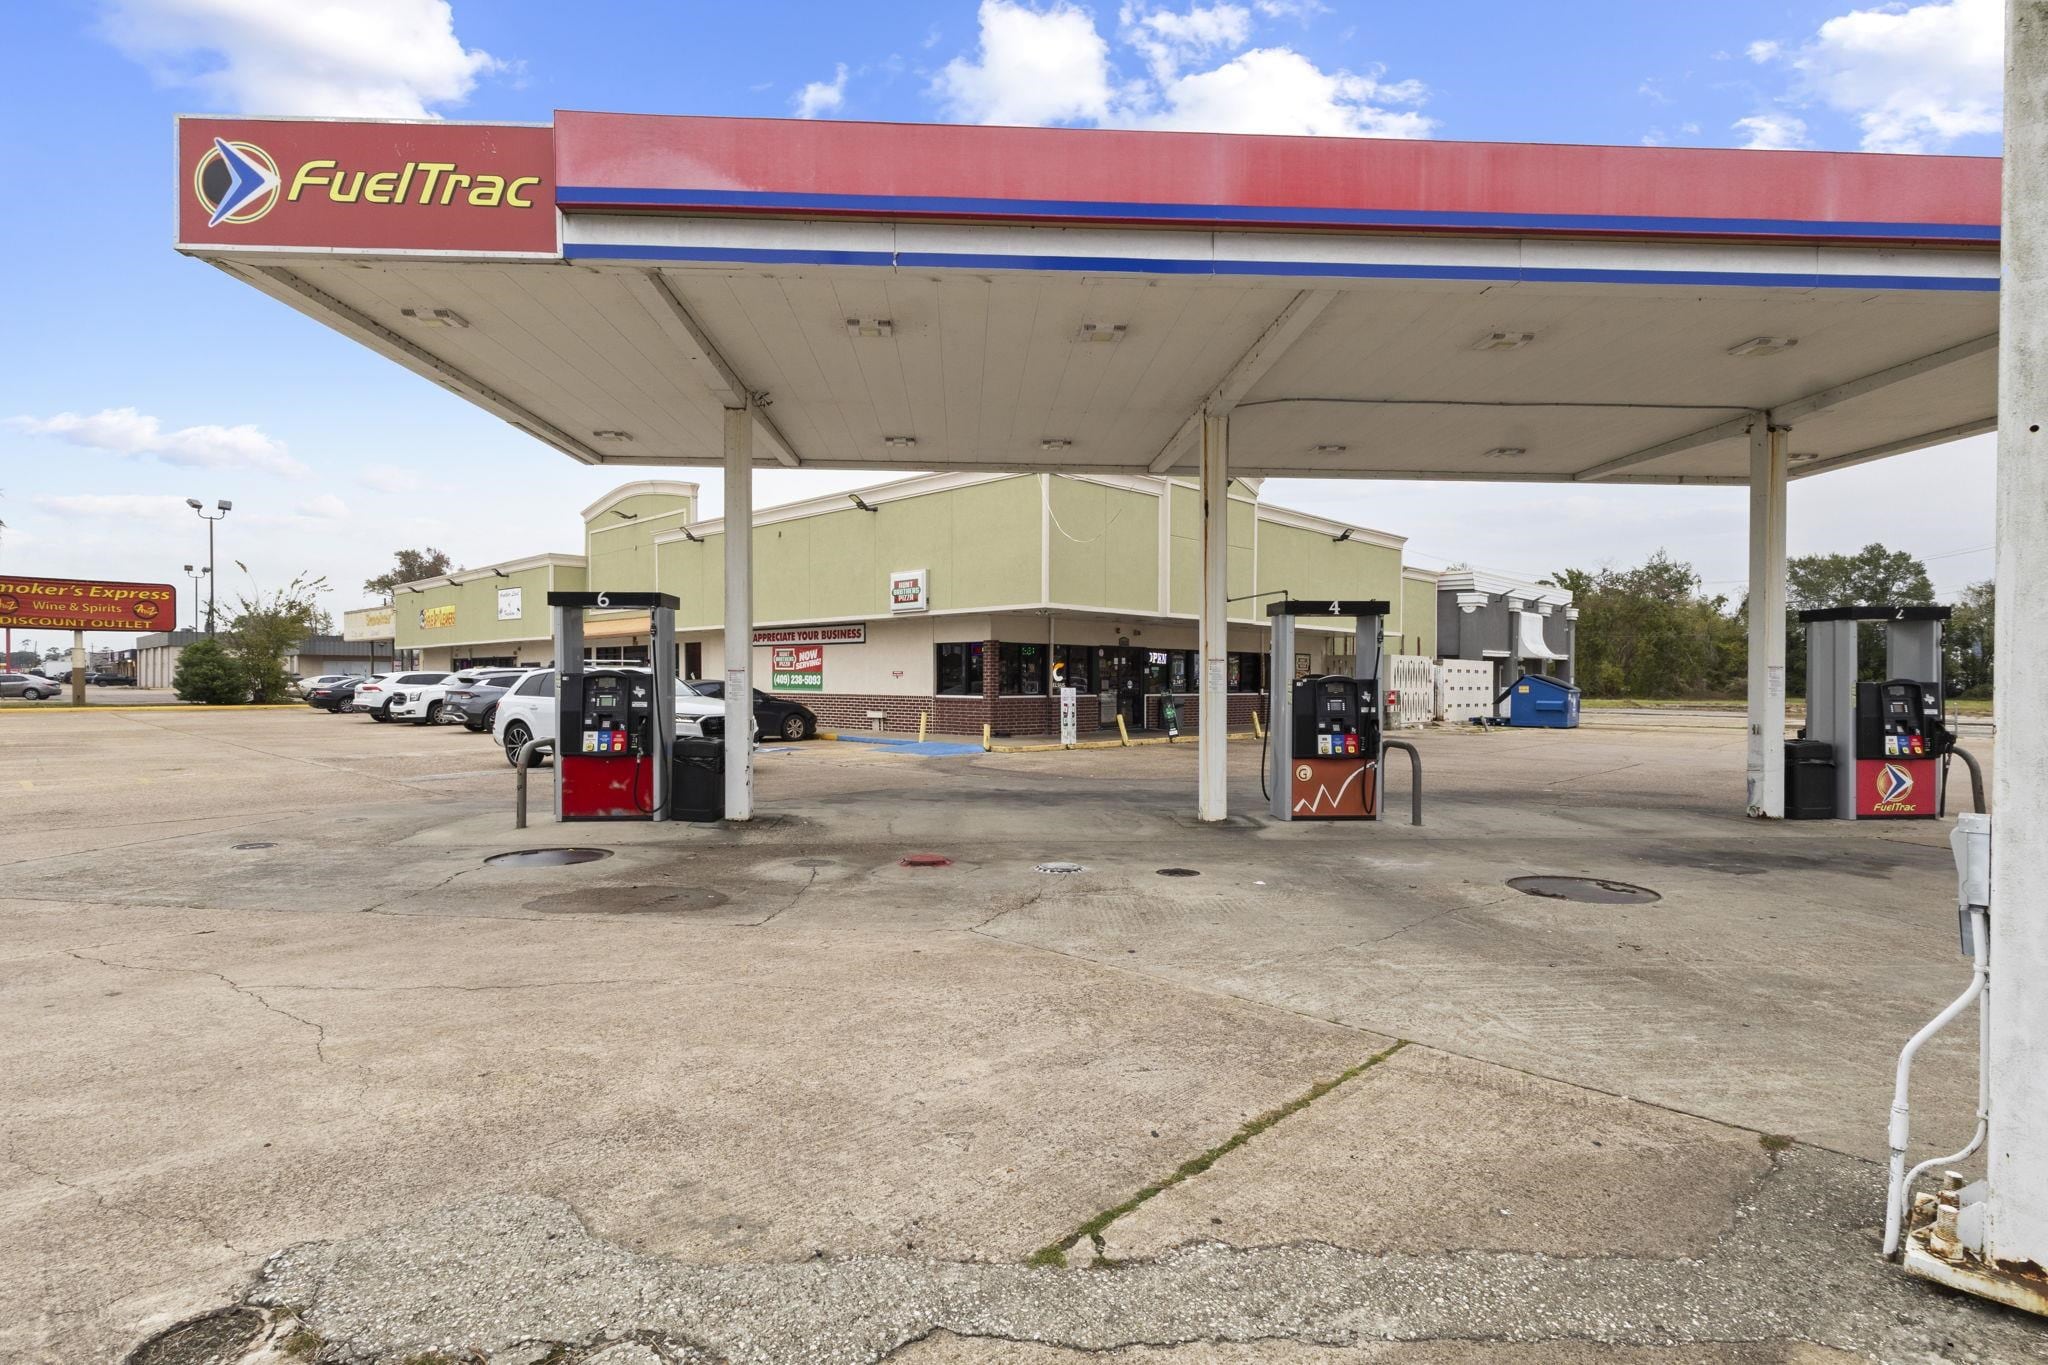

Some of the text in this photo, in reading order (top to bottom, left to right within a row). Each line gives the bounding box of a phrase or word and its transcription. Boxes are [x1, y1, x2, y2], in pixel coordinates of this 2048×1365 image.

[287, 160, 541, 208] FuelTrac
[0, 583, 170, 600] moker's Express
[597, 592, 610, 608] 6
[32, 601, 122, 613] Wine & Spirits
[1328, 600, 1341, 615] 4
[0, 617, 153, 629] DISCOUNT OUTLET
[753, 628, 862, 642] APPRECIATE YOUR BUSINESS
[799, 649, 817, 661] NOW
[796, 658, 821, 670] SERVING!
[774, 673, 790, 686] (409)
[1298, 767, 1308, 780] G
[1873, 802, 1916, 812] FuelTrac
